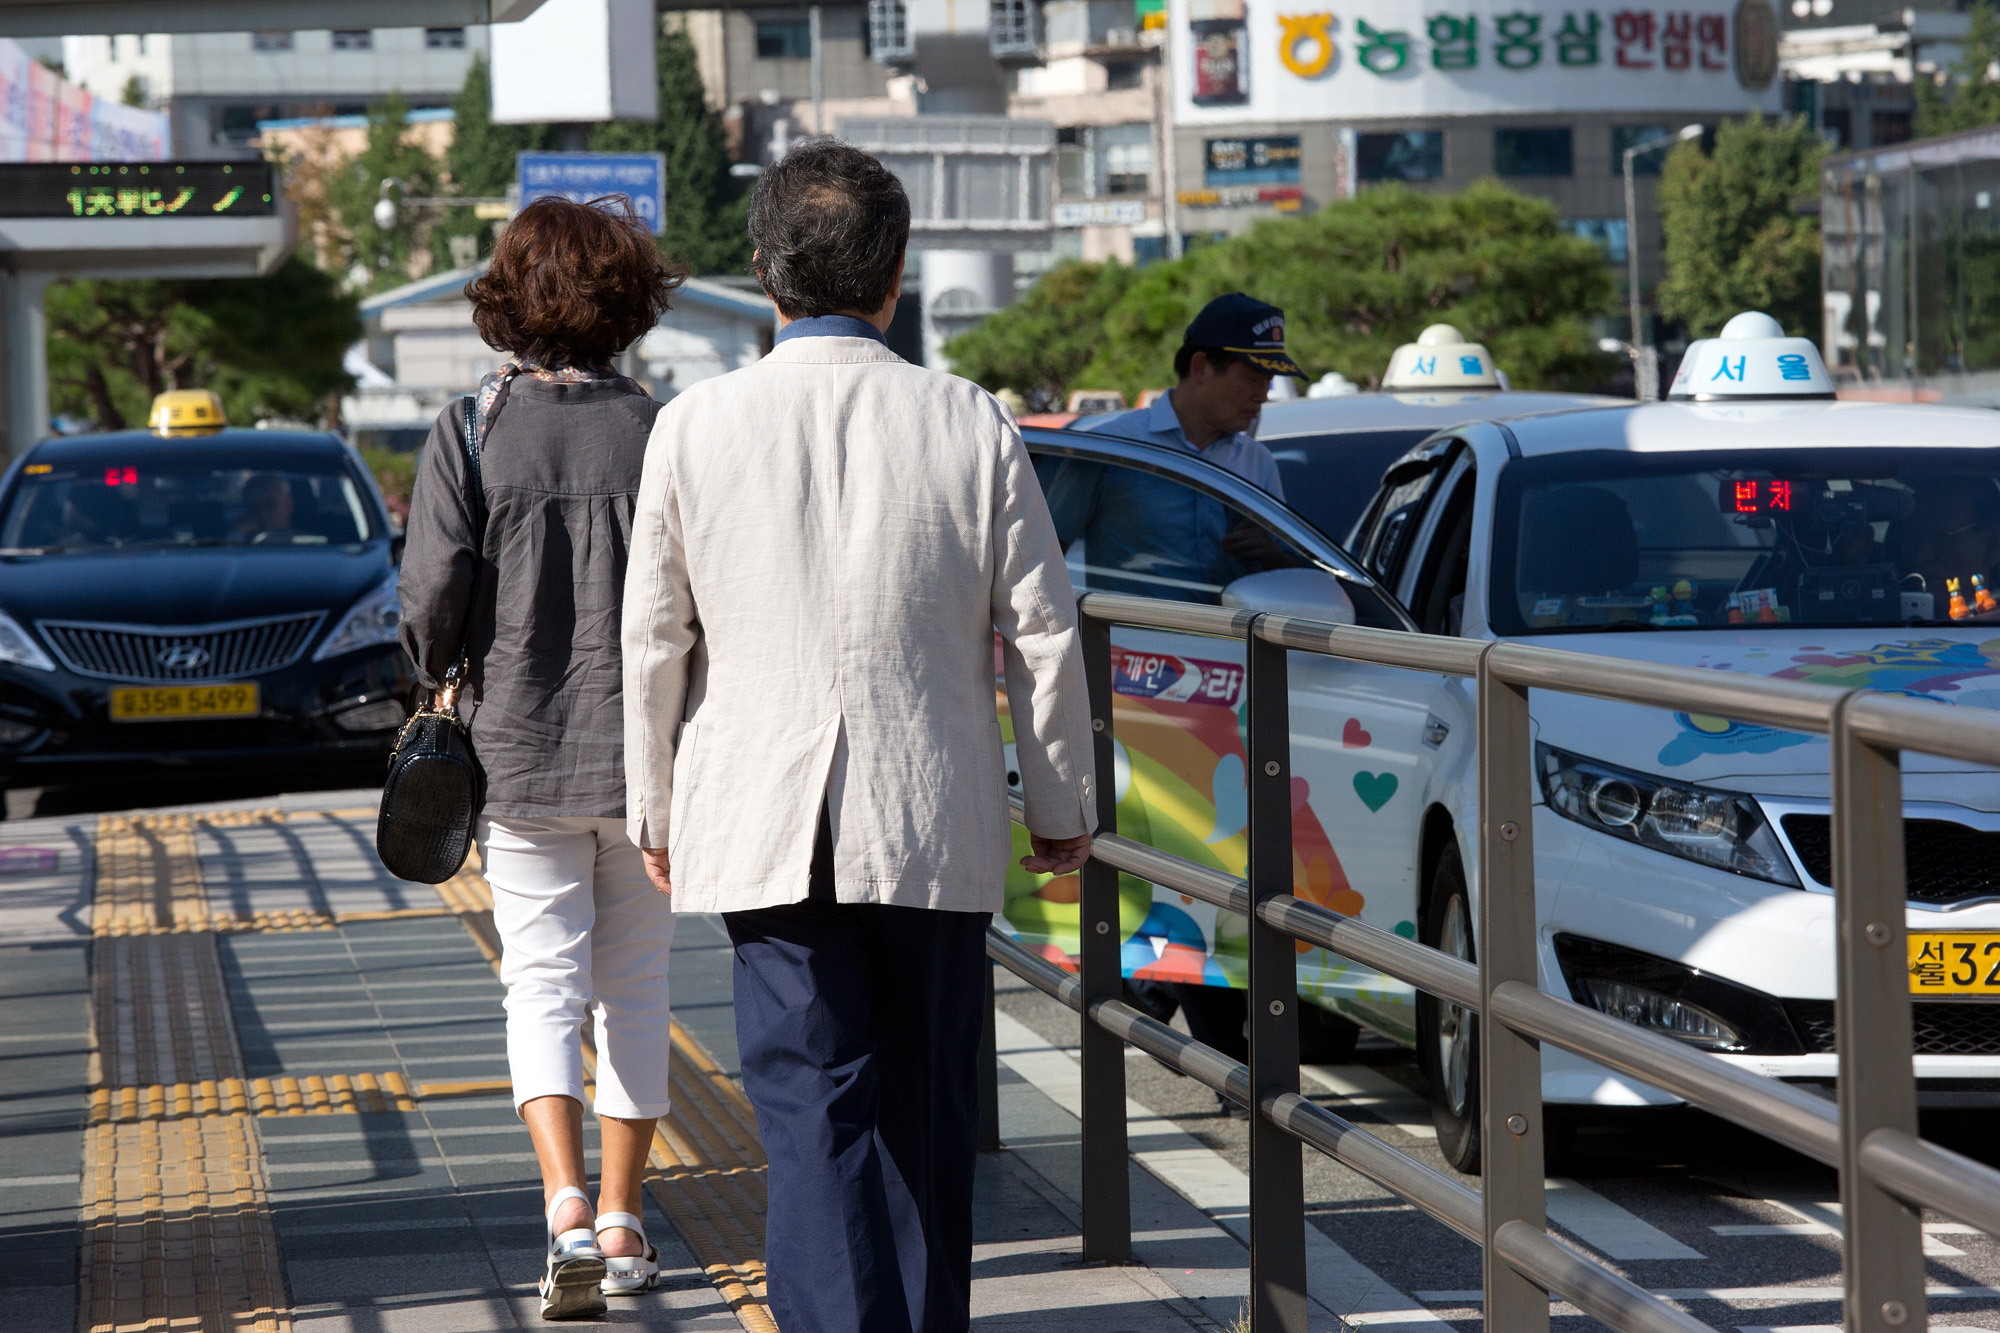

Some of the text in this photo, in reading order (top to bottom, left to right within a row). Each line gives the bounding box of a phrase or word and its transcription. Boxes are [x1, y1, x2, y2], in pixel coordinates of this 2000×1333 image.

[1355, 11, 1600, 73] 농협홍삼
[1409, 355, 1483, 376] 서울
[1711, 354, 1811, 381] 서울
[1736, 481, 1791, 512] 빈차
[1124, 655, 1166, 690] 개인
[187, 686, 248, 711] 5499
[1918, 941, 2000, 986] 서울 32
